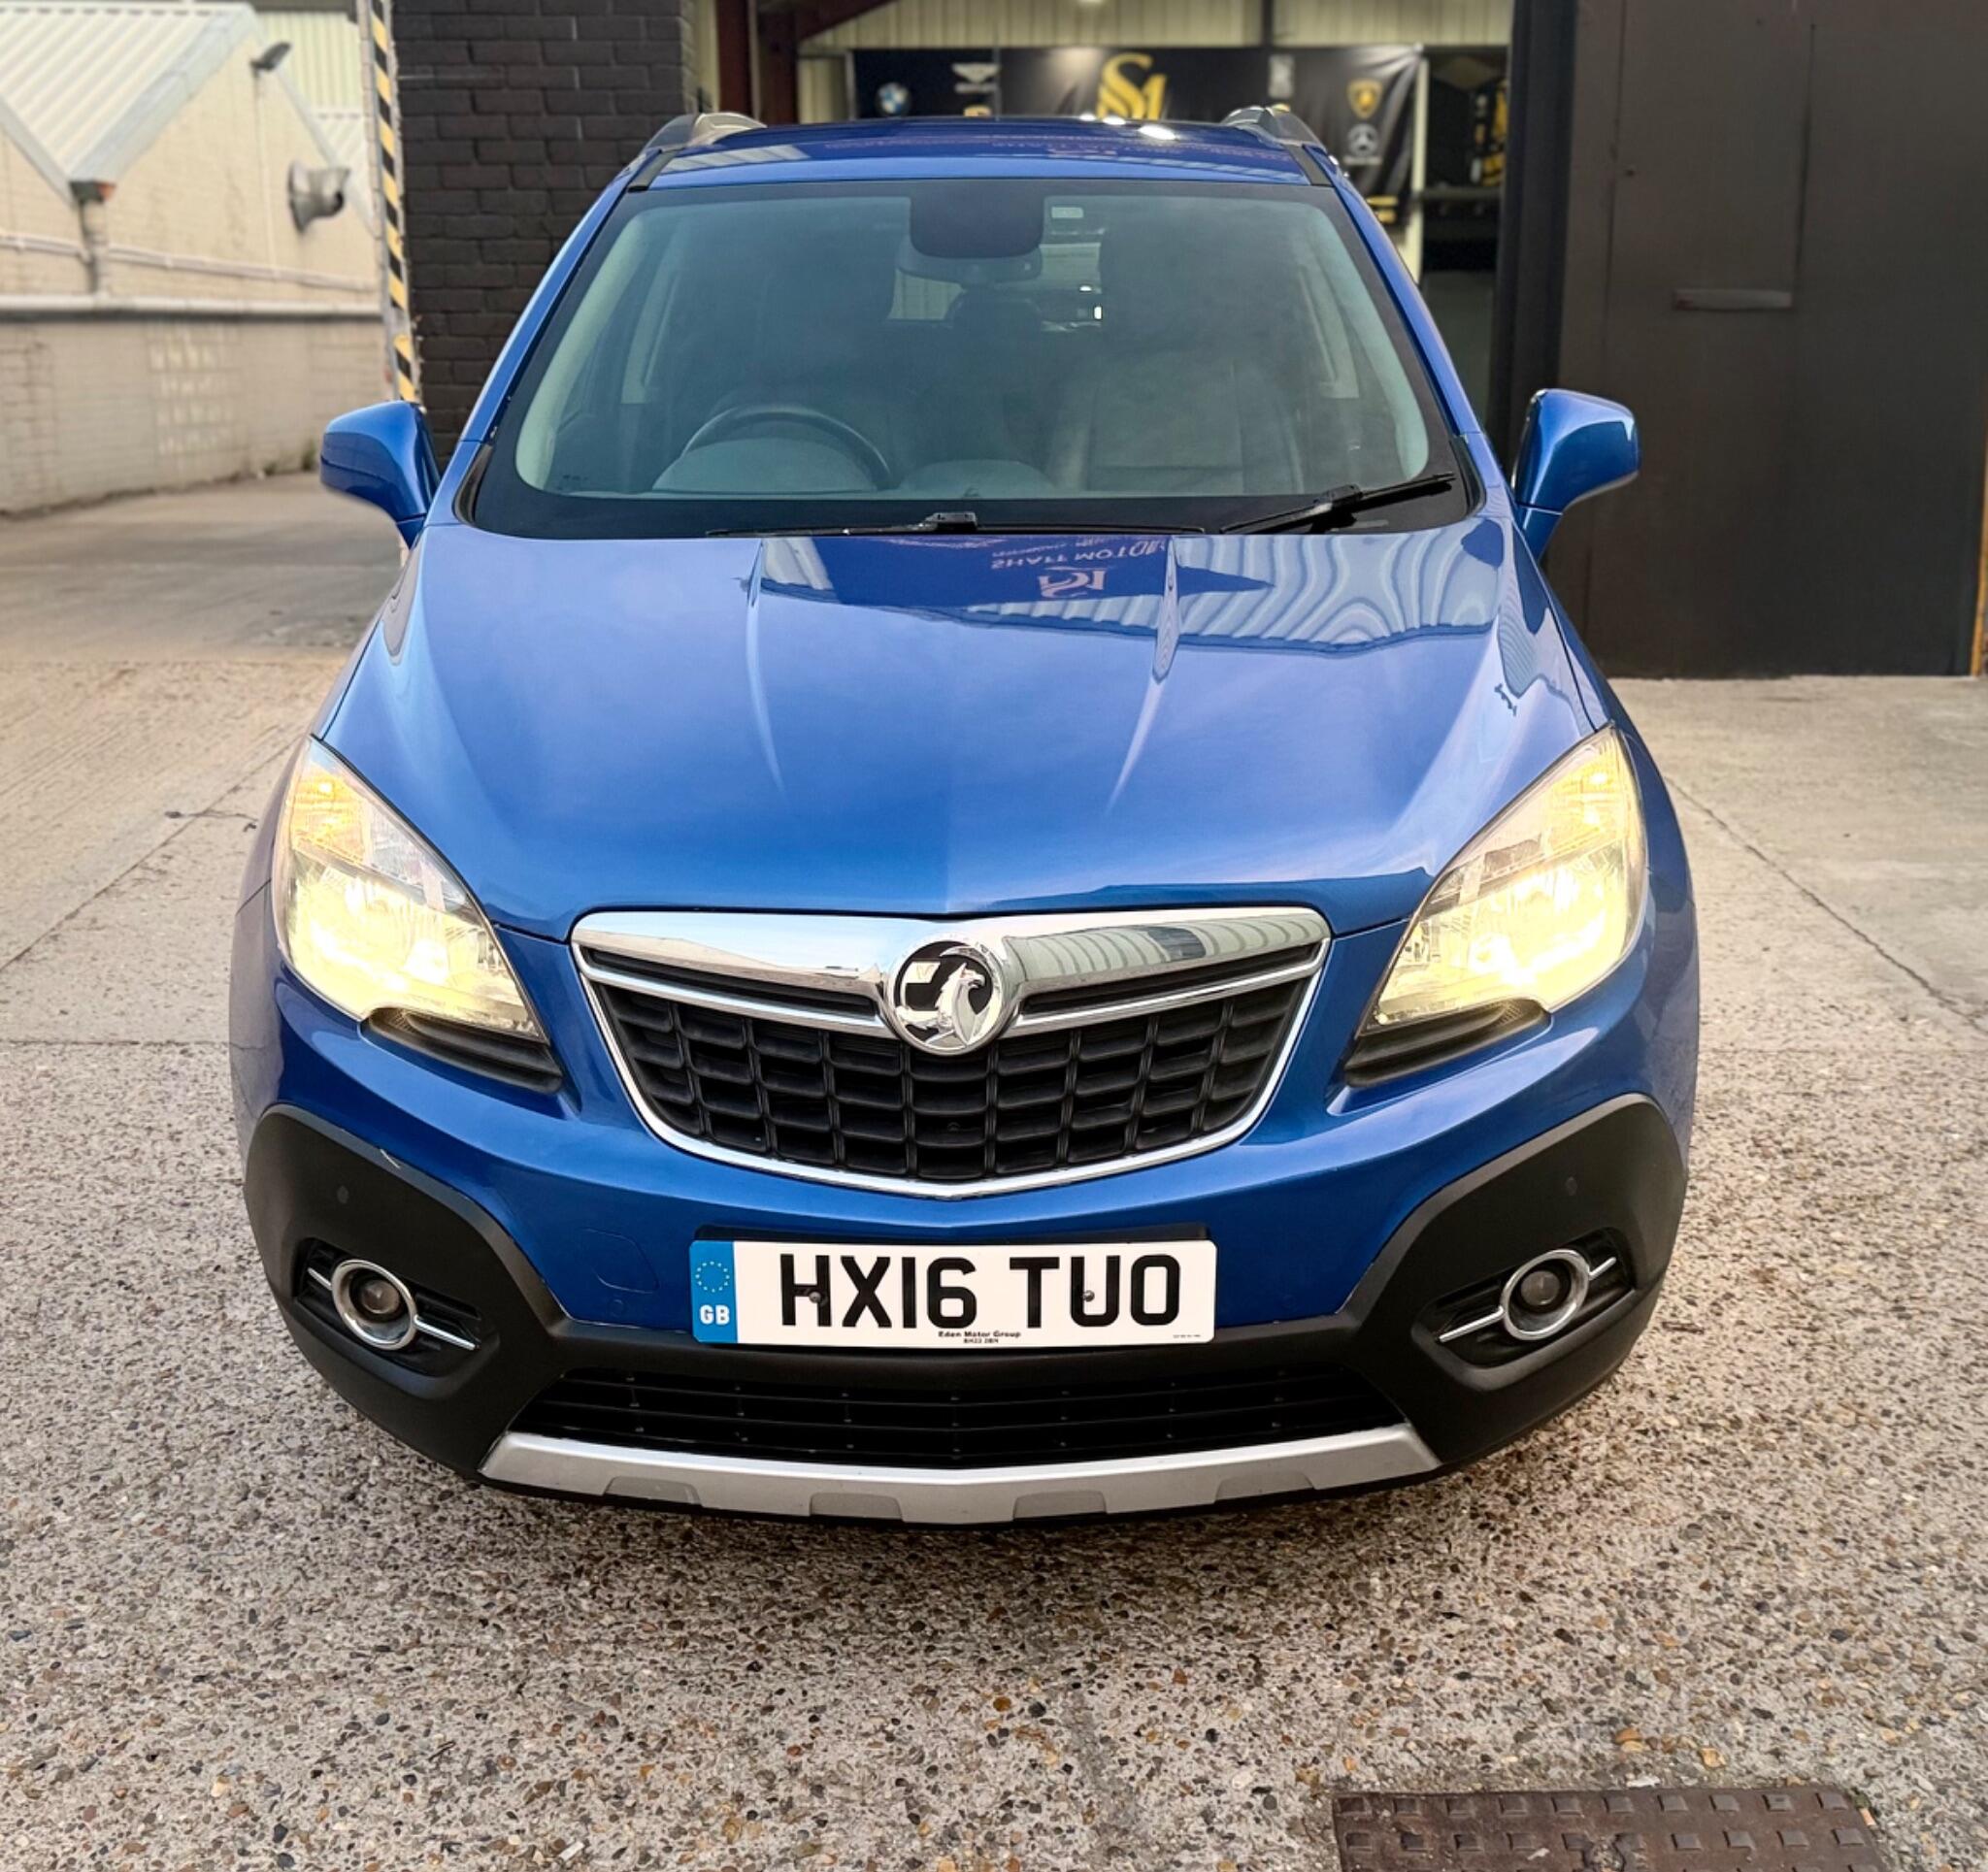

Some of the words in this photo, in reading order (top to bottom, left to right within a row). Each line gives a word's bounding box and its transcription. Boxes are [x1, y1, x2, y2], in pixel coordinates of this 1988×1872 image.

[779, 1253, 977, 1329] HX16
[1009, 1253, 1181, 1329] TUO
[700, 1304, 730, 1325] GB
[992, 1330, 1021, 1339] Group
